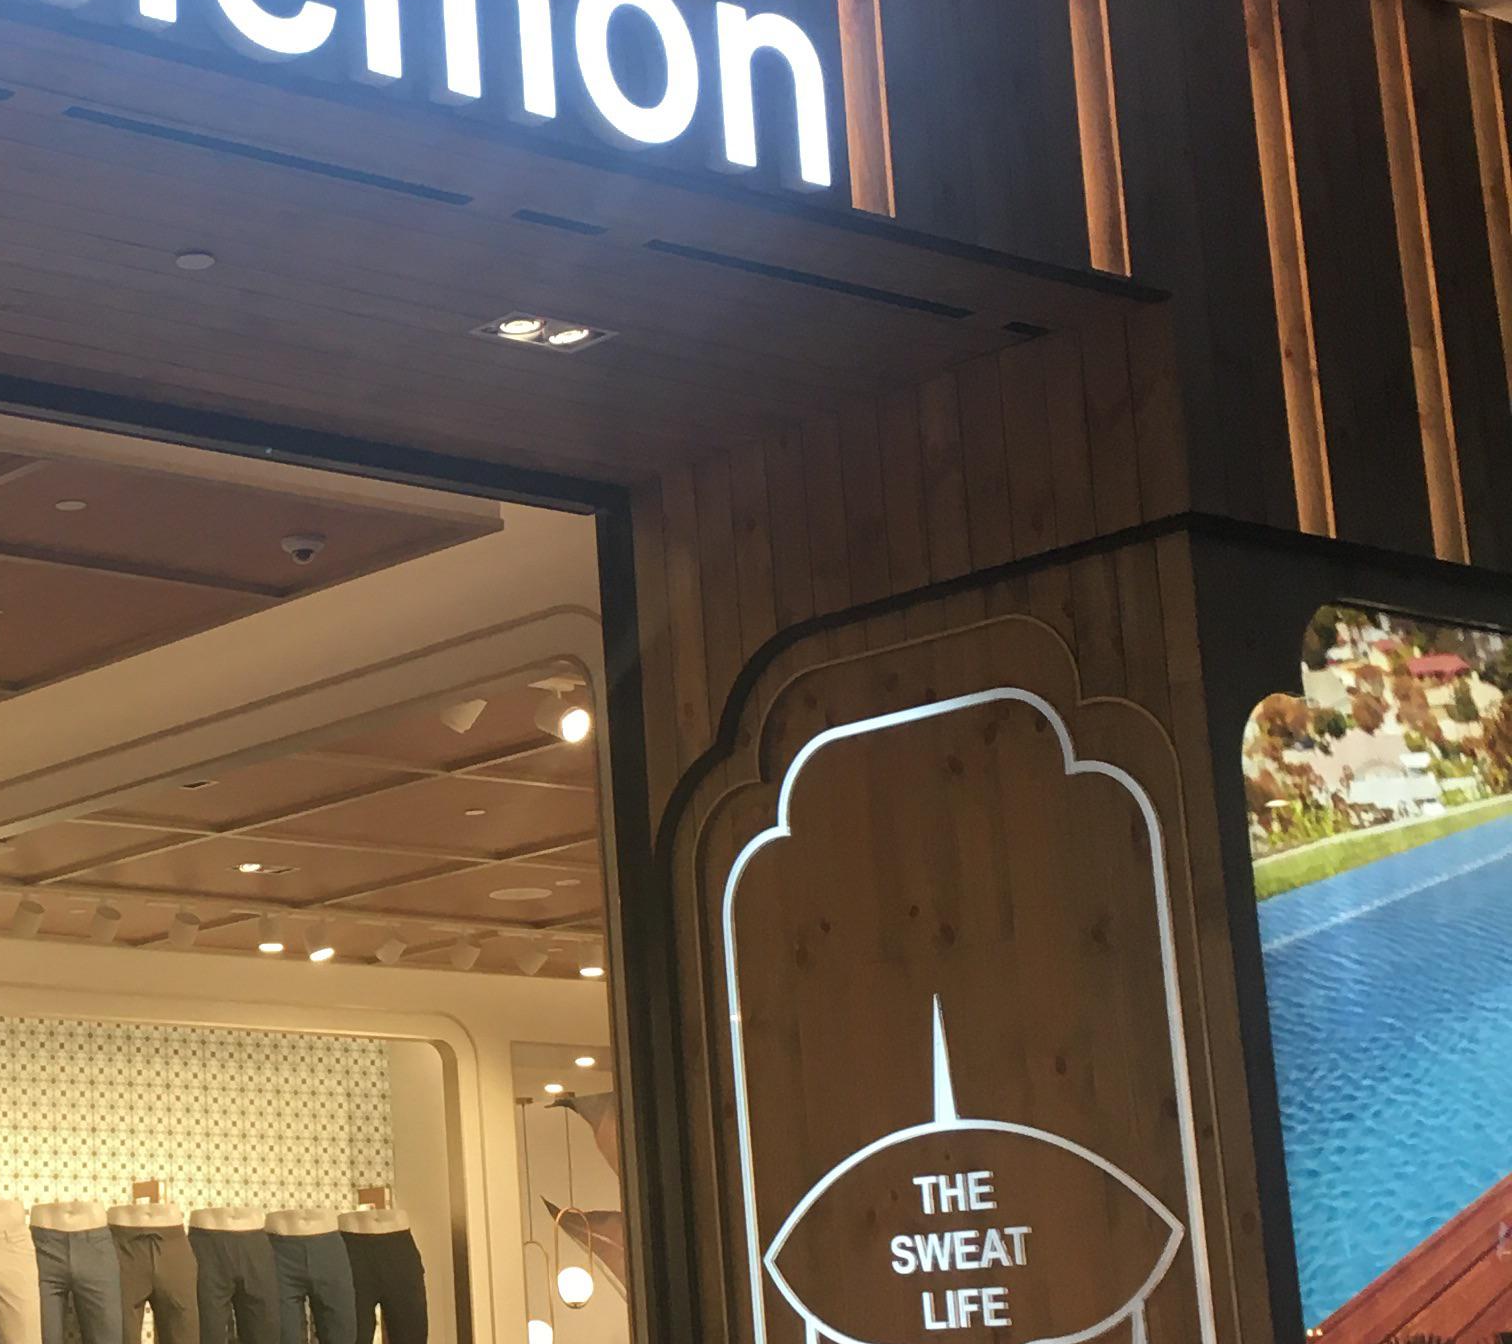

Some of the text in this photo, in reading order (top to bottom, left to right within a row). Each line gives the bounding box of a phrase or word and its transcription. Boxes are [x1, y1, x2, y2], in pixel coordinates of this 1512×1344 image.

[913, 1170, 998, 1214] THE
[890, 1225, 1033, 1275] SWEAT
[921, 1286, 1012, 1330] LIFE
